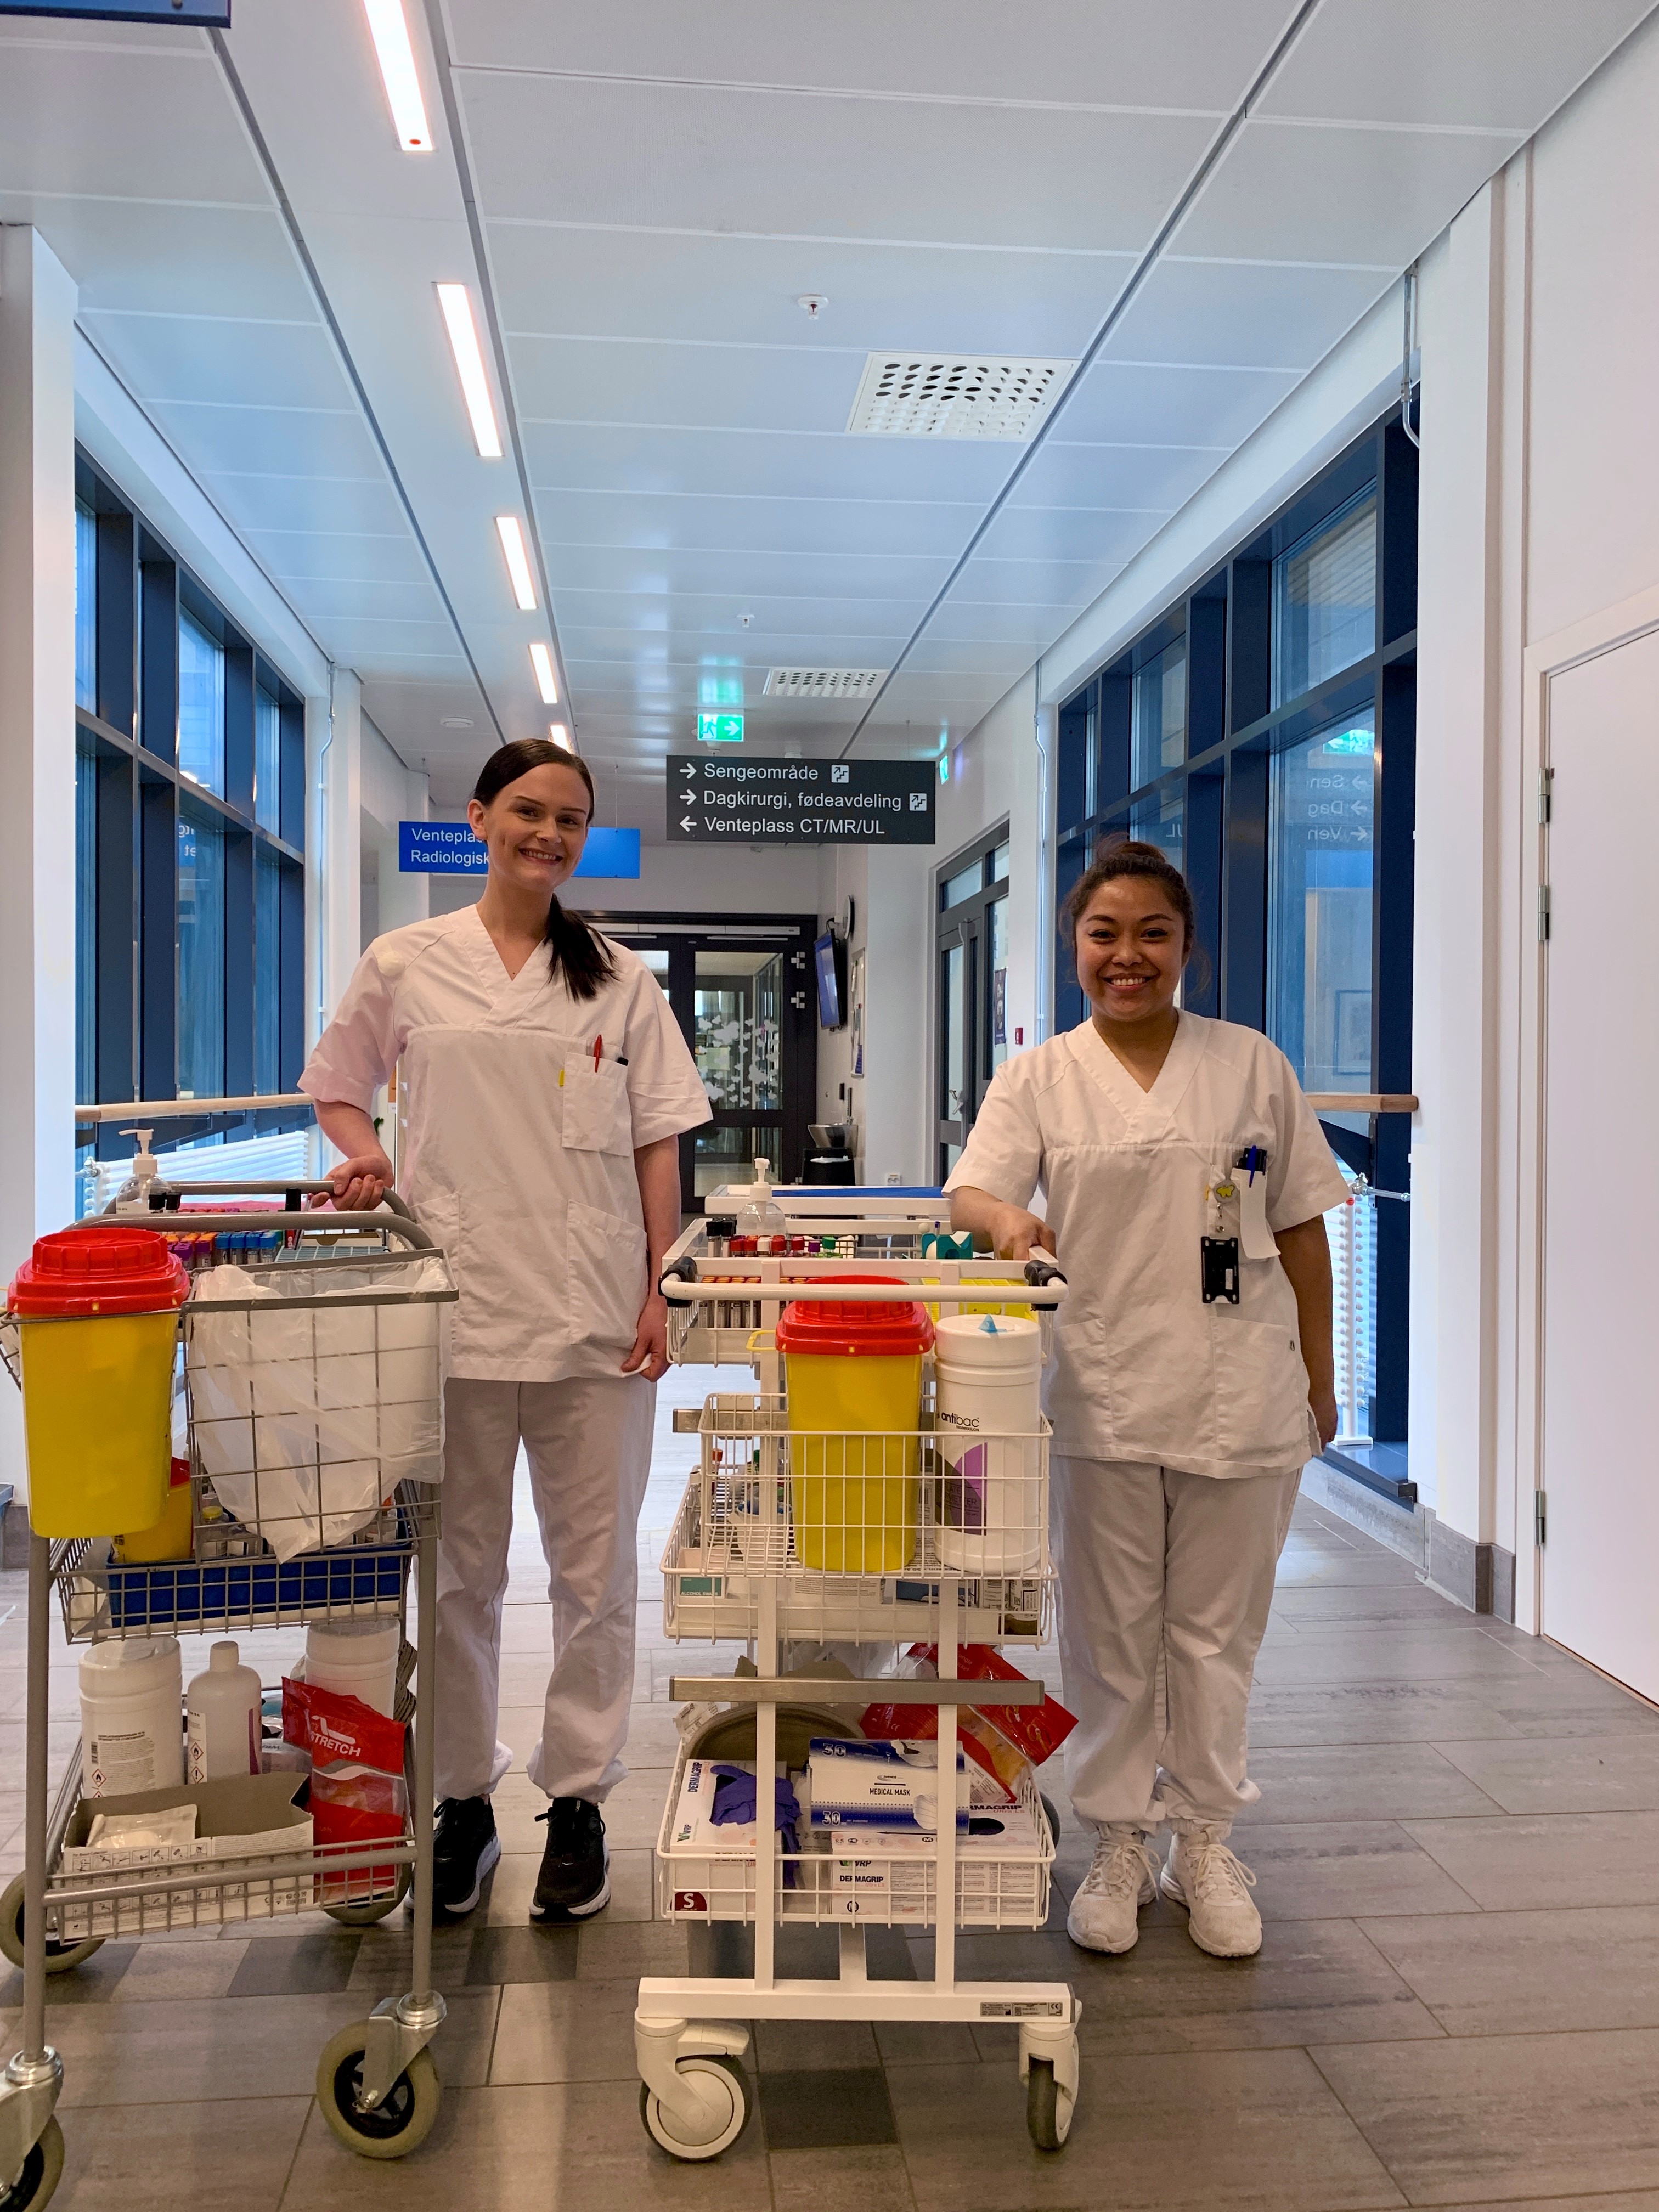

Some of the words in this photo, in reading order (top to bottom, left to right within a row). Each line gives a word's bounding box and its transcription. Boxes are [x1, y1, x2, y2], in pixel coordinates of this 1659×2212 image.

[704, 763, 818, 782] Sengeområde
[704, 790, 792, 809] Dagkirurgi,
[798, 792, 902, 811] fødeavdeling
[704, 816, 794, 834] Venteplass
[799, 819, 885, 834] CT/MR/UL
[411, 828, 483, 845] Ventepla
[411, 849, 489, 867] Radiologisk
[941, 1412, 979, 1427] antibac
[311, 1730, 361, 1757] STRETCH
[822, 1743, 847, 1757] 30
[687, 1762, 703, 1793] DERMAGRIP
[822, 1811, 841, 1826] 30
[684, 1893, 694, 1909] S
